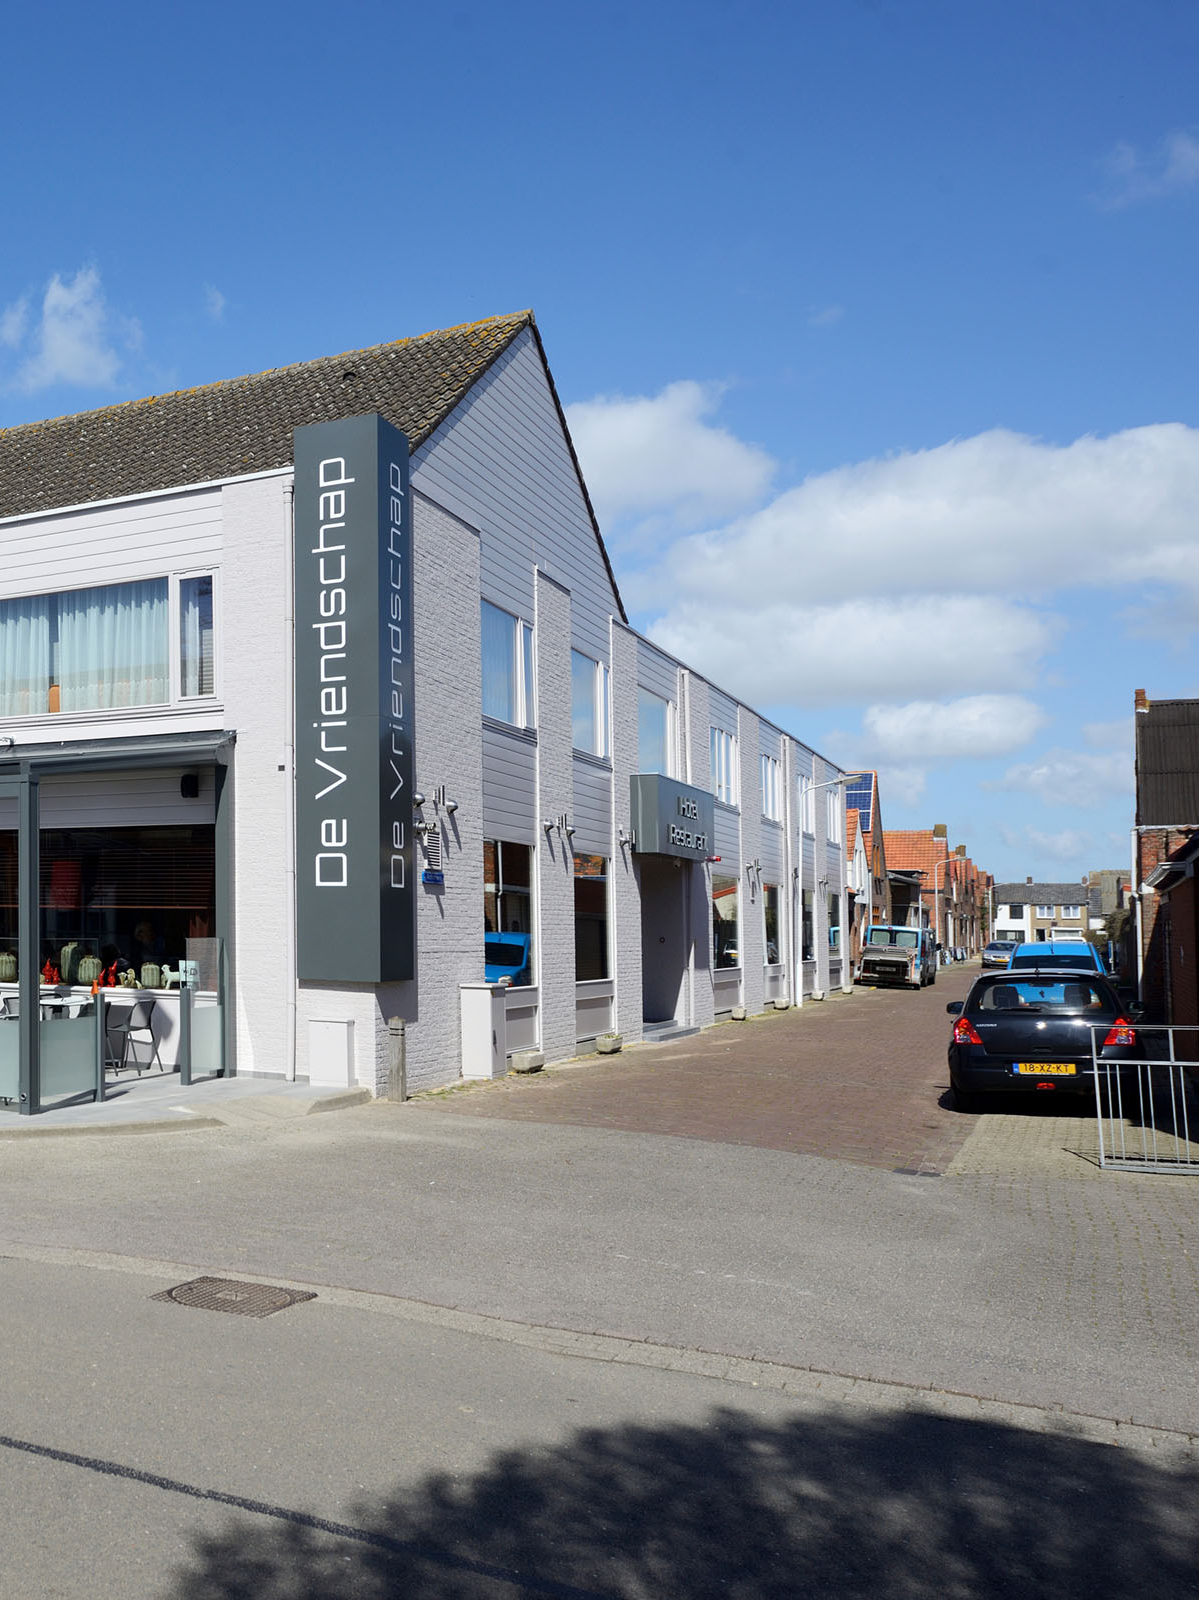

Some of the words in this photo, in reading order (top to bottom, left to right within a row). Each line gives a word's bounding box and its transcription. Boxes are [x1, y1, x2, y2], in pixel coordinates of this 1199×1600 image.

[311, 457, 355, 800] Vriendschap
[387, 462, 405, 800] Vriendschap
[315, 818, 348, 887] De
[391, 821, 405, 888] De
[669, 824, 709, 852] Restaurant
[1024, 1063, 1070, 1073] 18-XZ-KT
